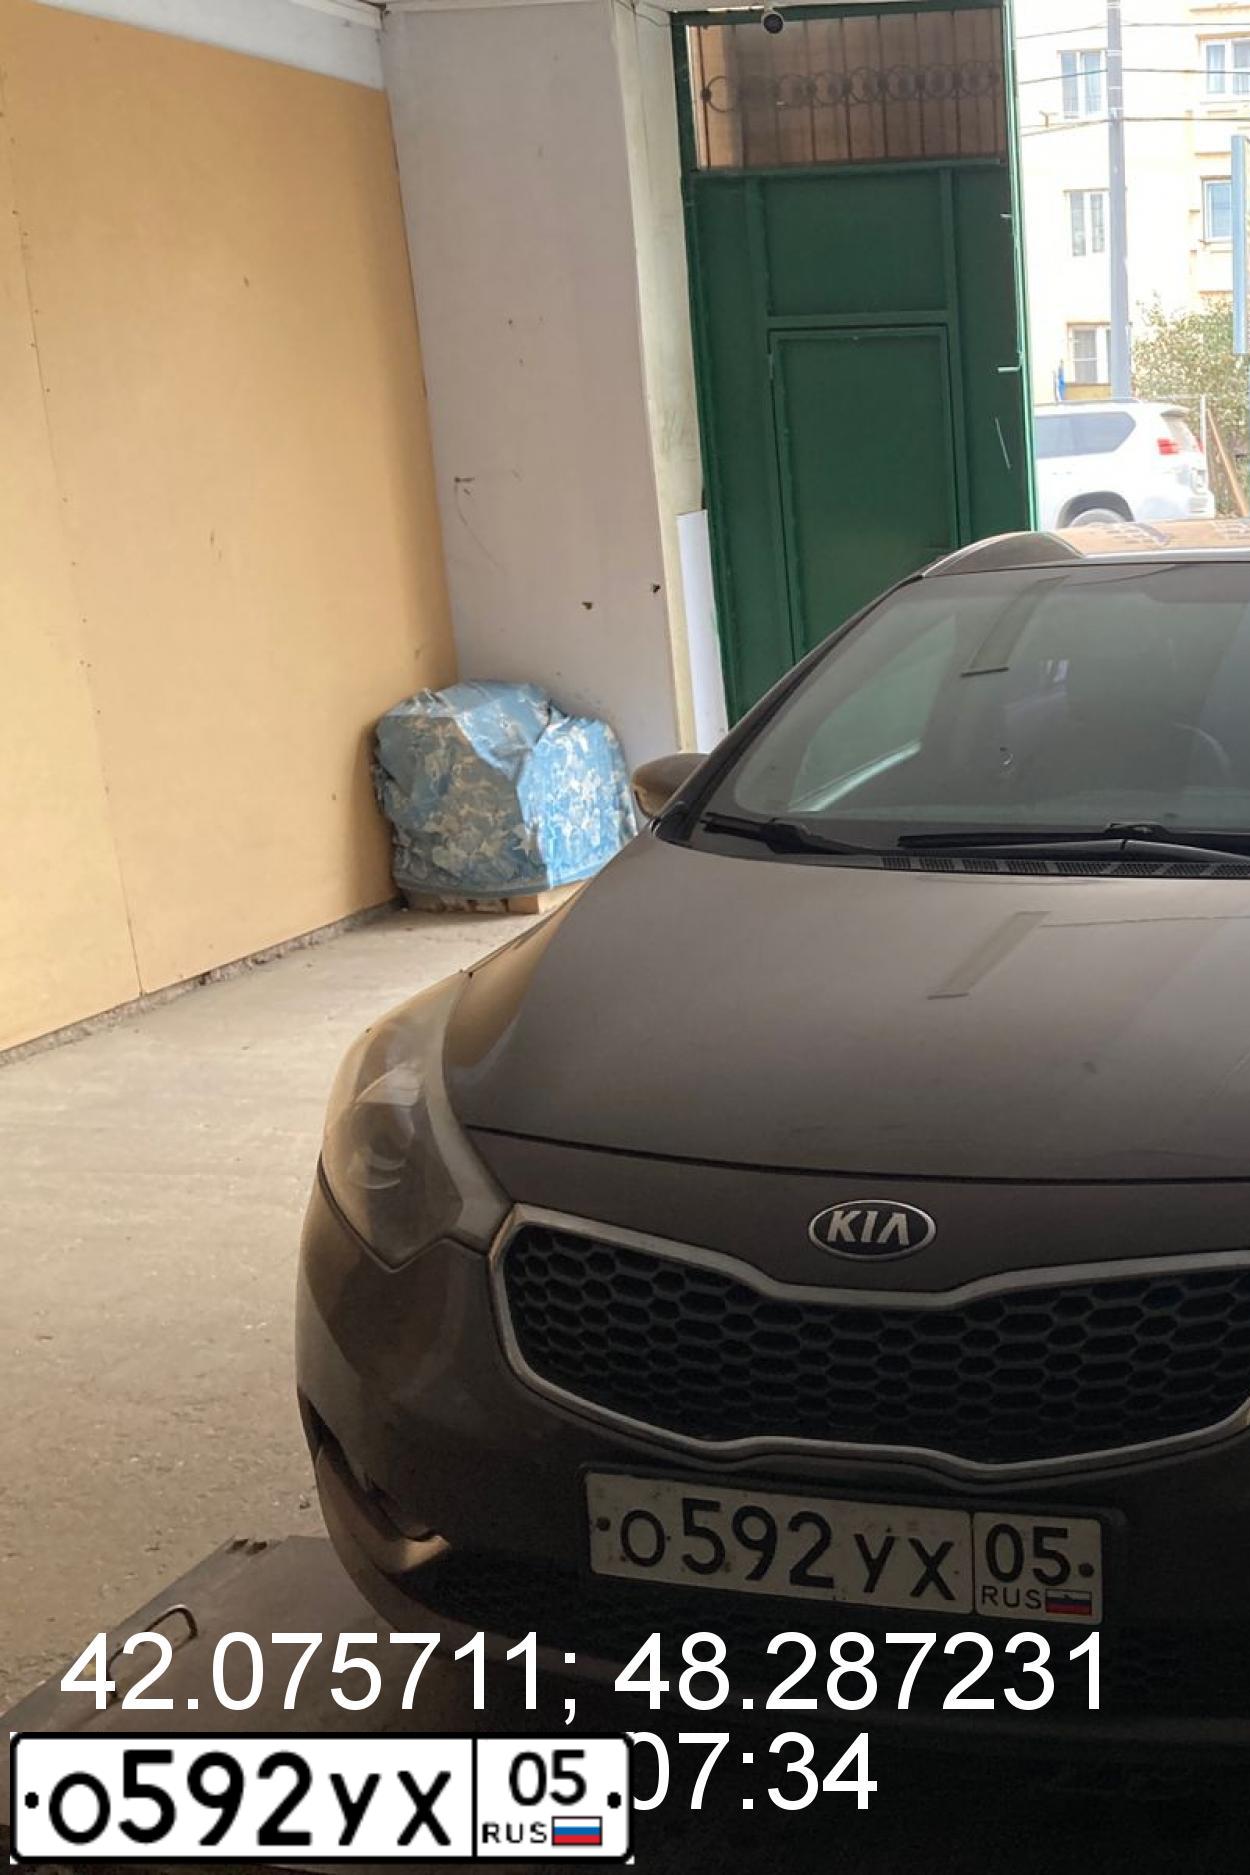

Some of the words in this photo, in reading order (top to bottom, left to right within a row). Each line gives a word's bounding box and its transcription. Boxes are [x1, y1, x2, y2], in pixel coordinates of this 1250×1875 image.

[827, 1210, 909, 1246] KIA
[985, 1523, 1071, 1587] 05
[981, 1585, 1042, 1610] RUS
